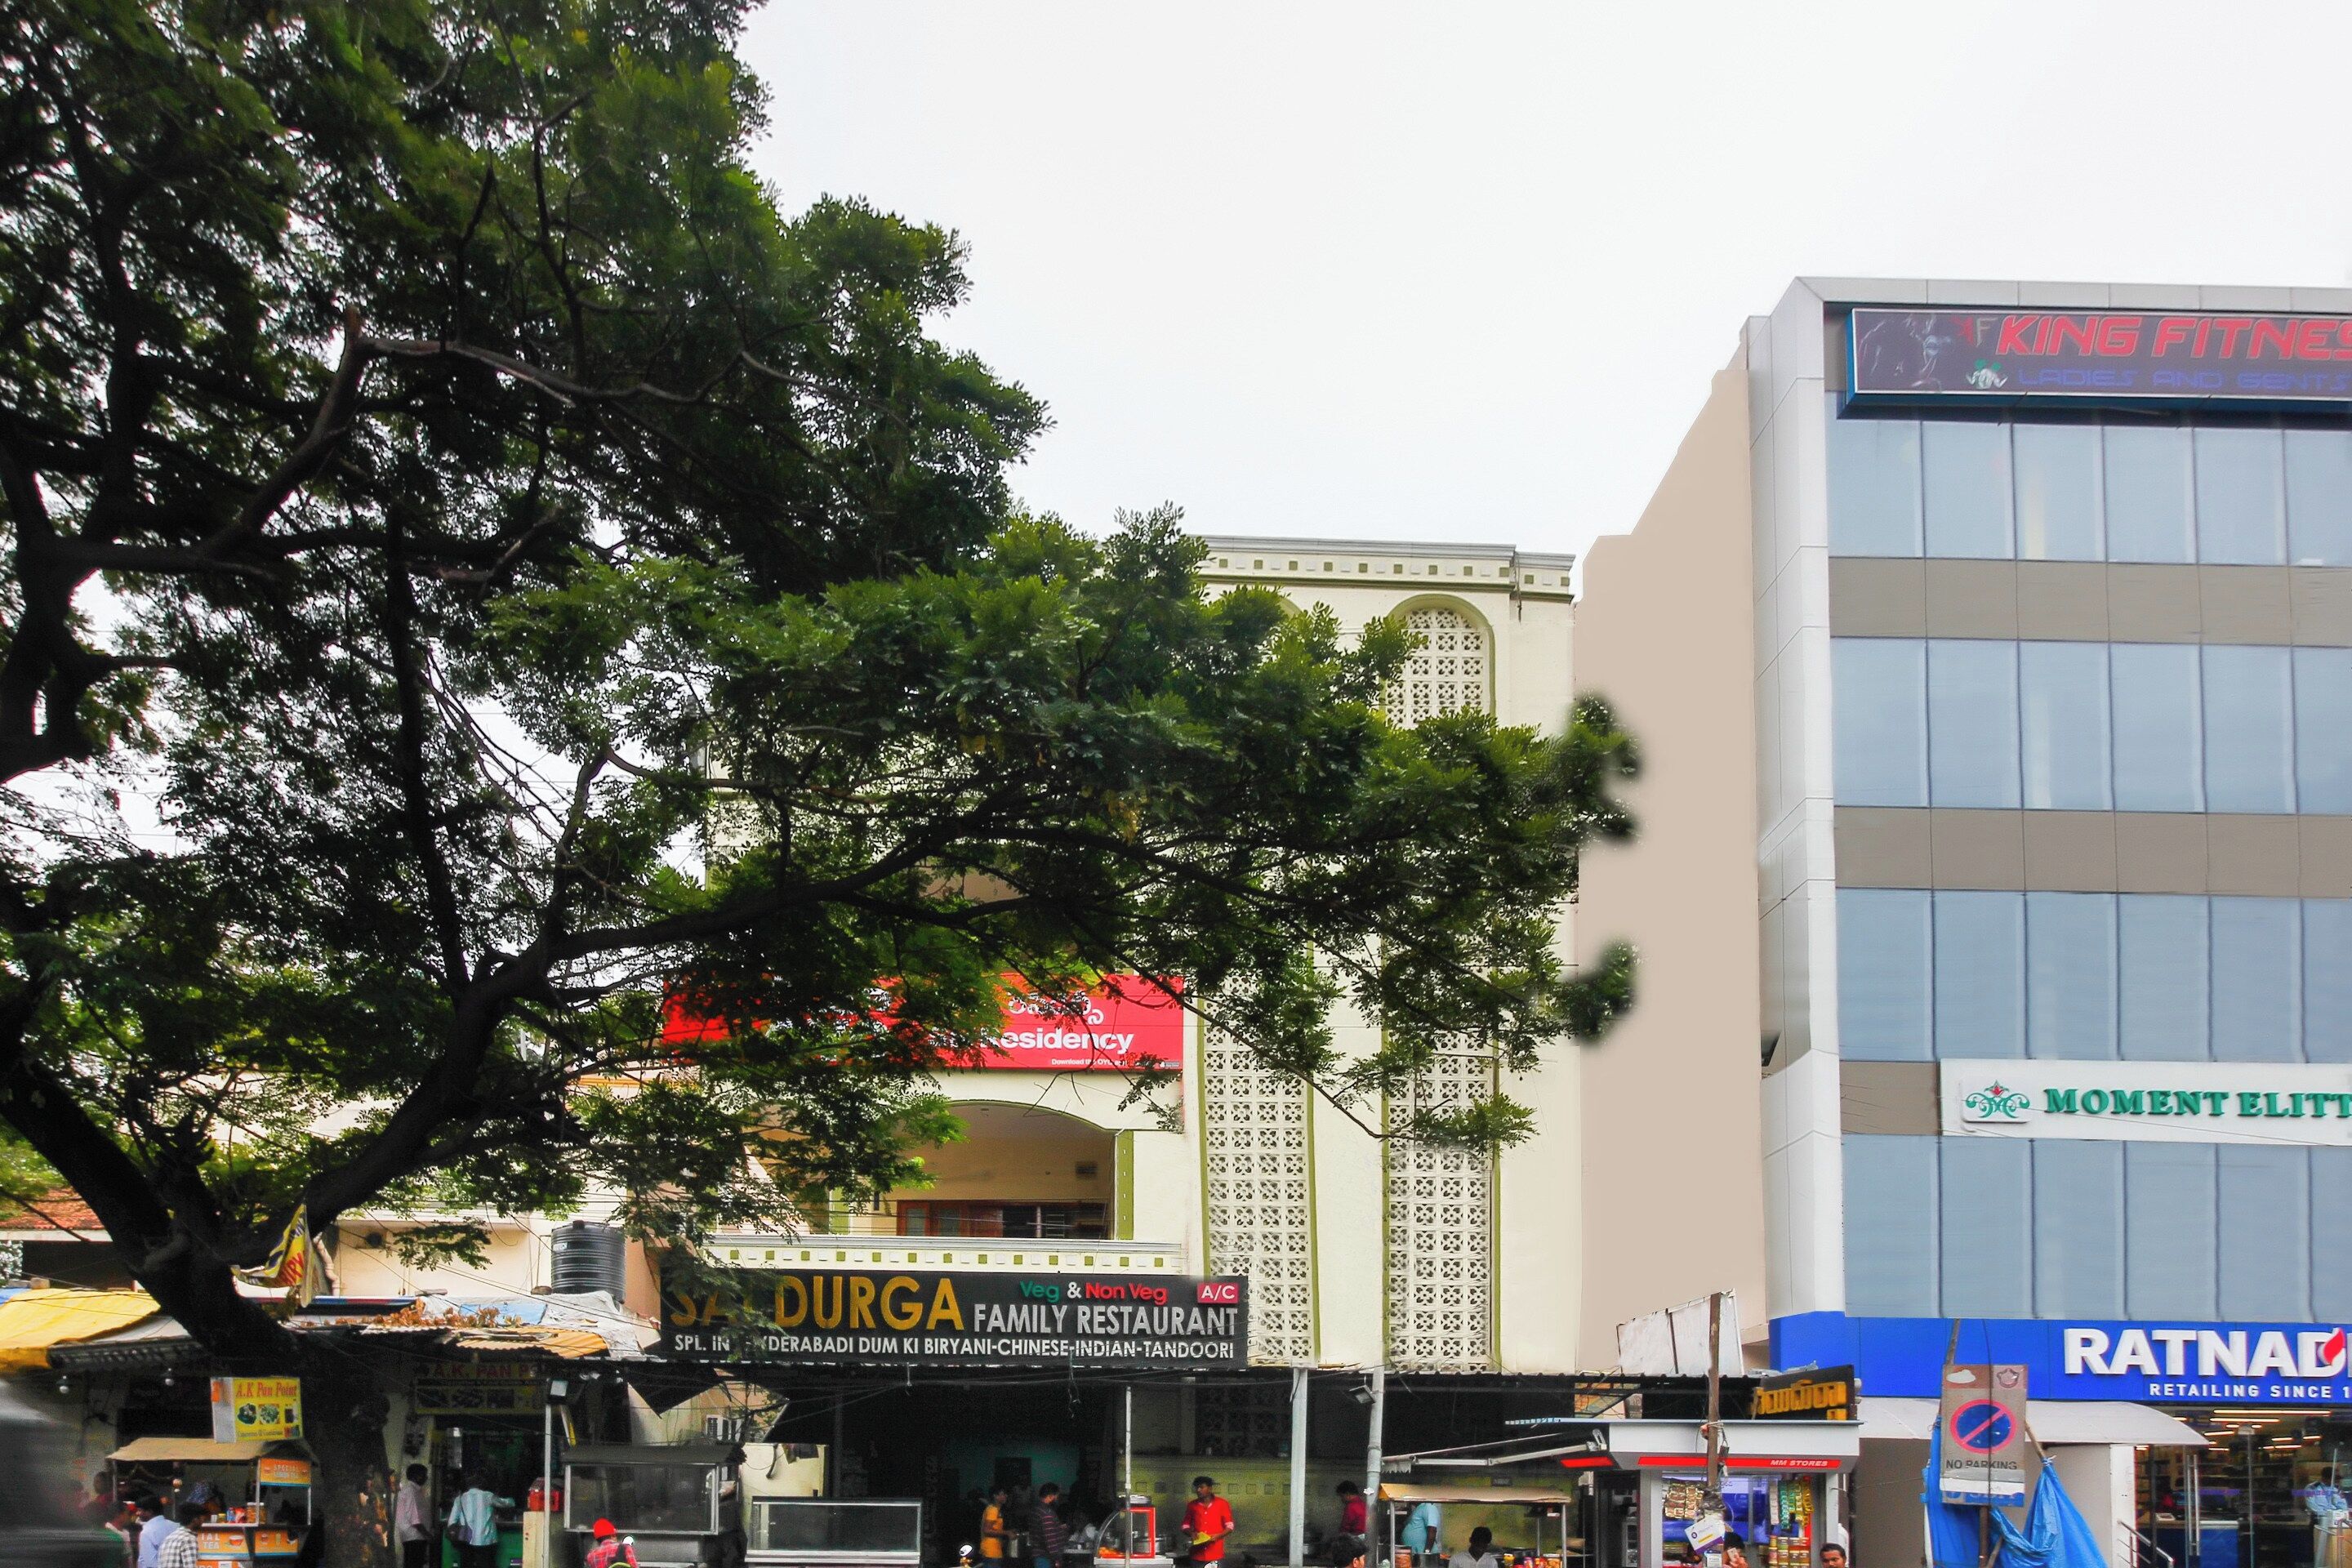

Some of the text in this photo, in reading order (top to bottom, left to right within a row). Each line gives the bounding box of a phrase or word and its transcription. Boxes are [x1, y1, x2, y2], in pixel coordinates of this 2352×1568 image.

[1996, 315, 2143, 358] KING
[2018, 368, 2138, 388] LADIES
[2152, 371, 2226, 389] AND
[1051, 1058, 1086, 1067] Download
[2042, 1088, 2230, 1116] MOMENT
[775, 1275, 965, 1331] DURGA
[1020, 1280, 1169, 1306] Veg & Non Veg
[1200, 1285, 1236, 1301] A/C
[973, 1303, 1239, 1336] FAMILY RESTAURANT
[858, 1337, 898, 1354] DUM
[903, 1338, 919, 1355] KI
[2149, 1383, 2260, 1399] RETAILING
[2270, 1385, 2332, 1399] SINCE
[1946, 1459, 2017, 1470] NO PARKING
